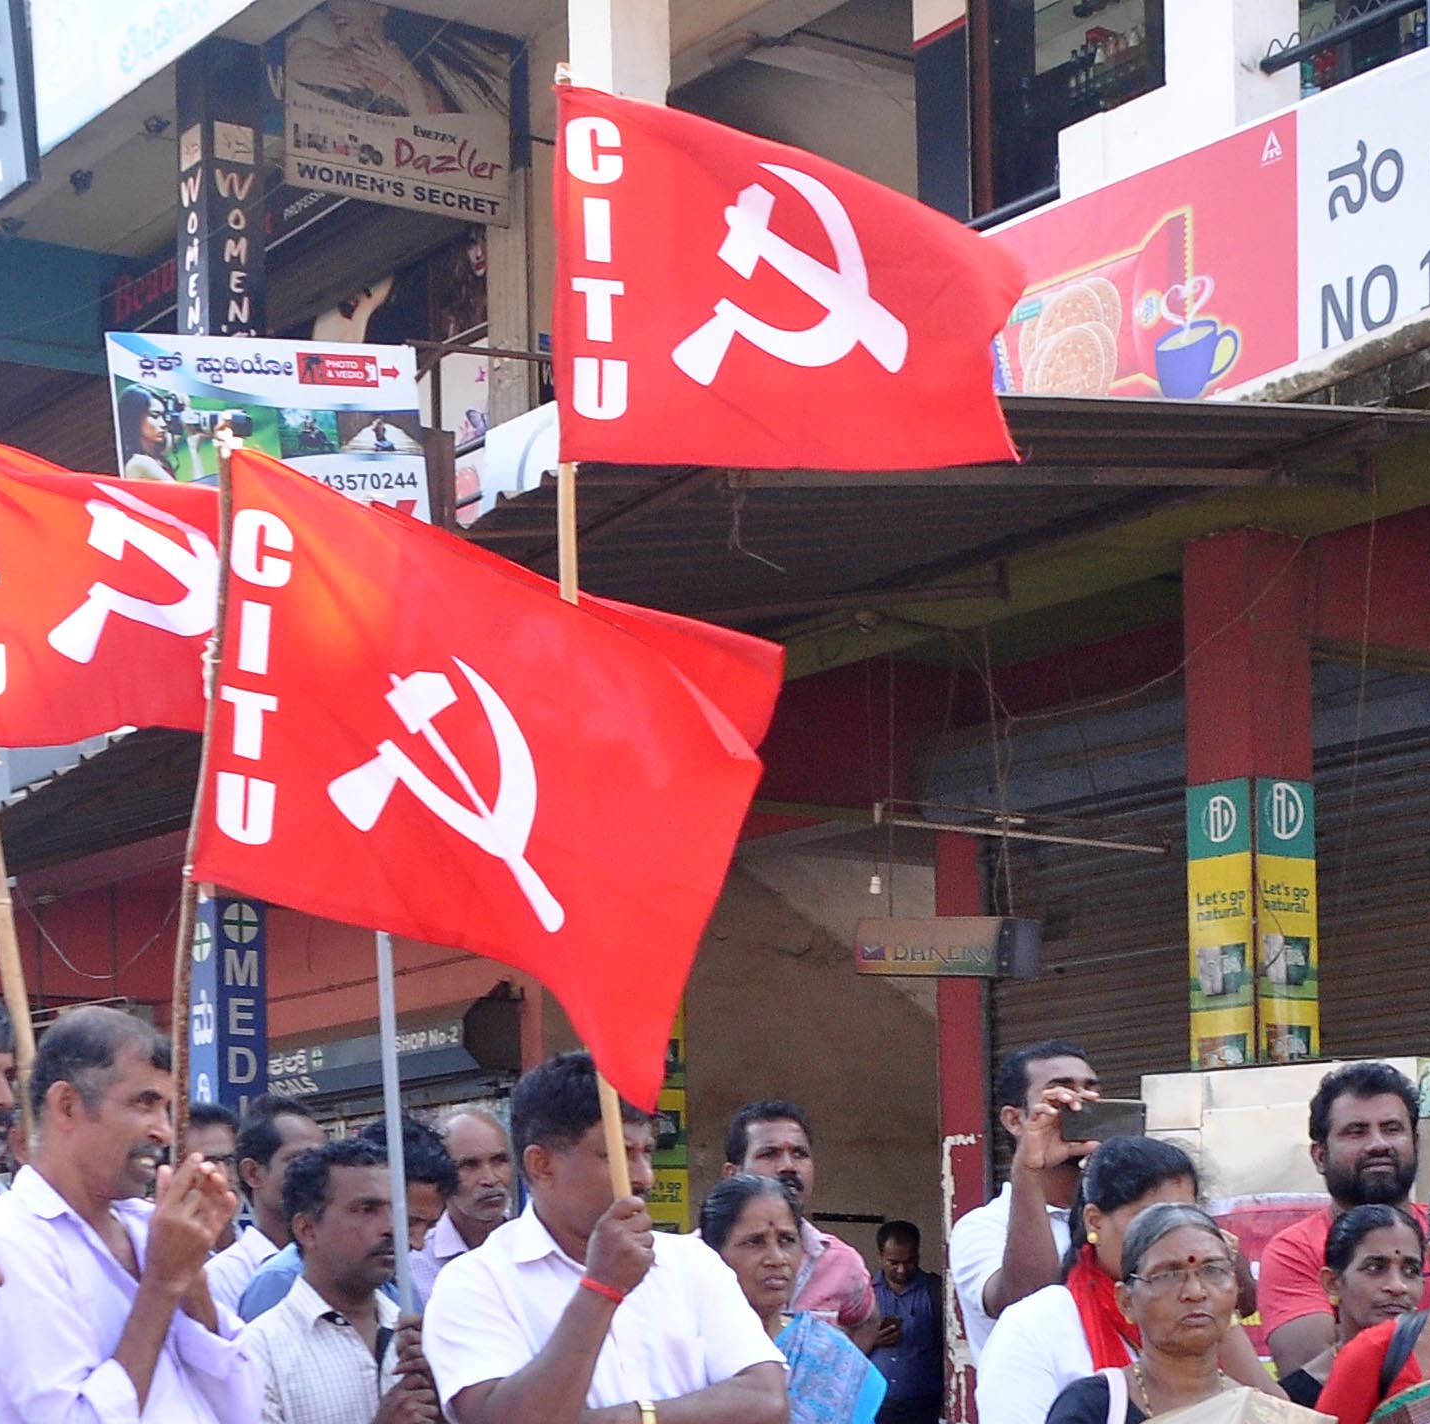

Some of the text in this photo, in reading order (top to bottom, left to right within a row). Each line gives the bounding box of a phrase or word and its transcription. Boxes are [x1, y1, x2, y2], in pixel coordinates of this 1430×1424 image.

[297, 162, 500, 216] WOMEN'S SECRET
[1327, 139, 1404, 221] ನಂ
[565, 116, 628, 420] CITU
[1321, 264, 1398, 349] NO
[325, 358, 359, 369] PHOTO
[337, 369, 366, 380] VEDIO
[311, 472, 418, 490] 43570244
[216, 508, 294, 846] CITU
[1196, 888, 1246, 907] Let's go
[1262, 879, 1310, 901] Let's go
[395, 1031, 428, 1051] SHOP
